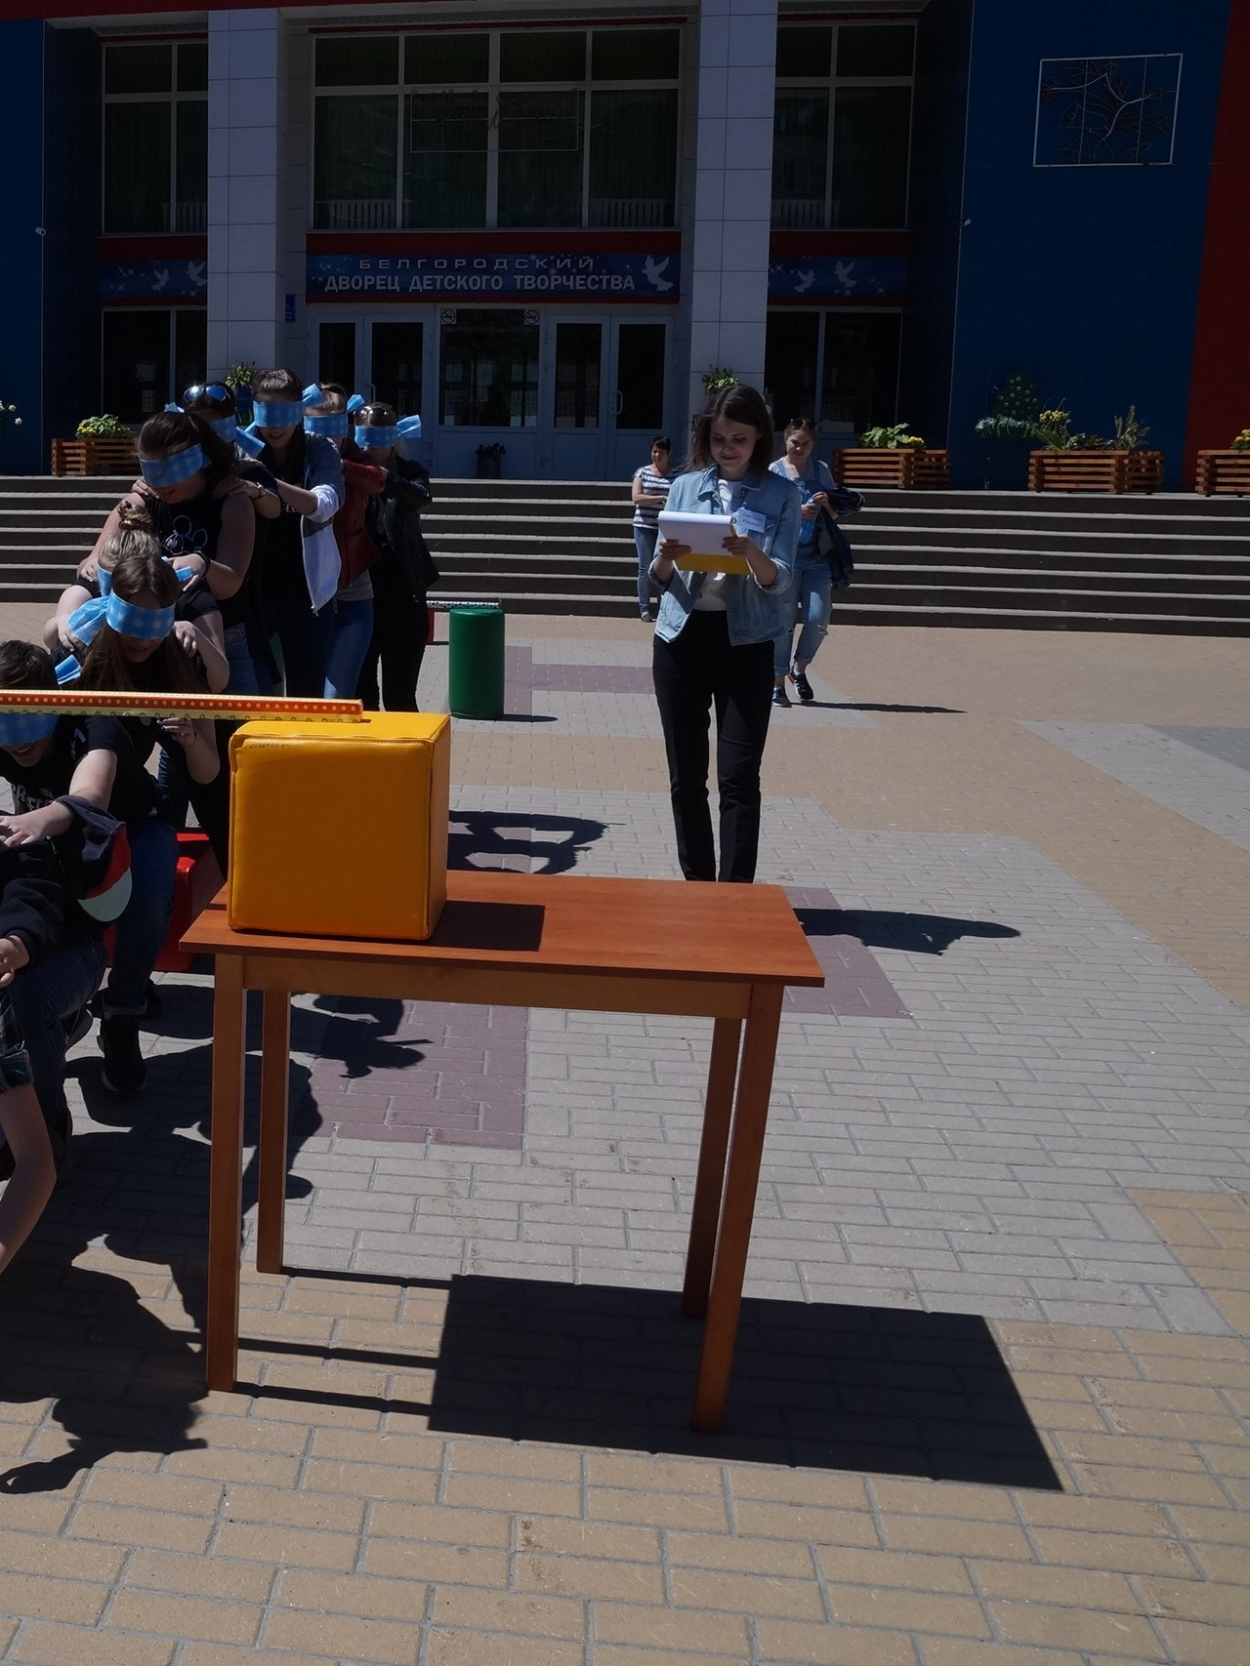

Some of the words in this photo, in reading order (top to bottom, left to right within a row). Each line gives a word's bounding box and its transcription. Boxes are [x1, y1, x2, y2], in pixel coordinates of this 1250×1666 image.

[359, 256, 595, 271] БЕЛГОРОДСКИЙ
[324, 275, 400, 293] ДВОРЕЦ
[409, 274, 503, 292] ДЕТСКОГО
[514, 273, 635, 291] ТВОРЧЕСТВА
